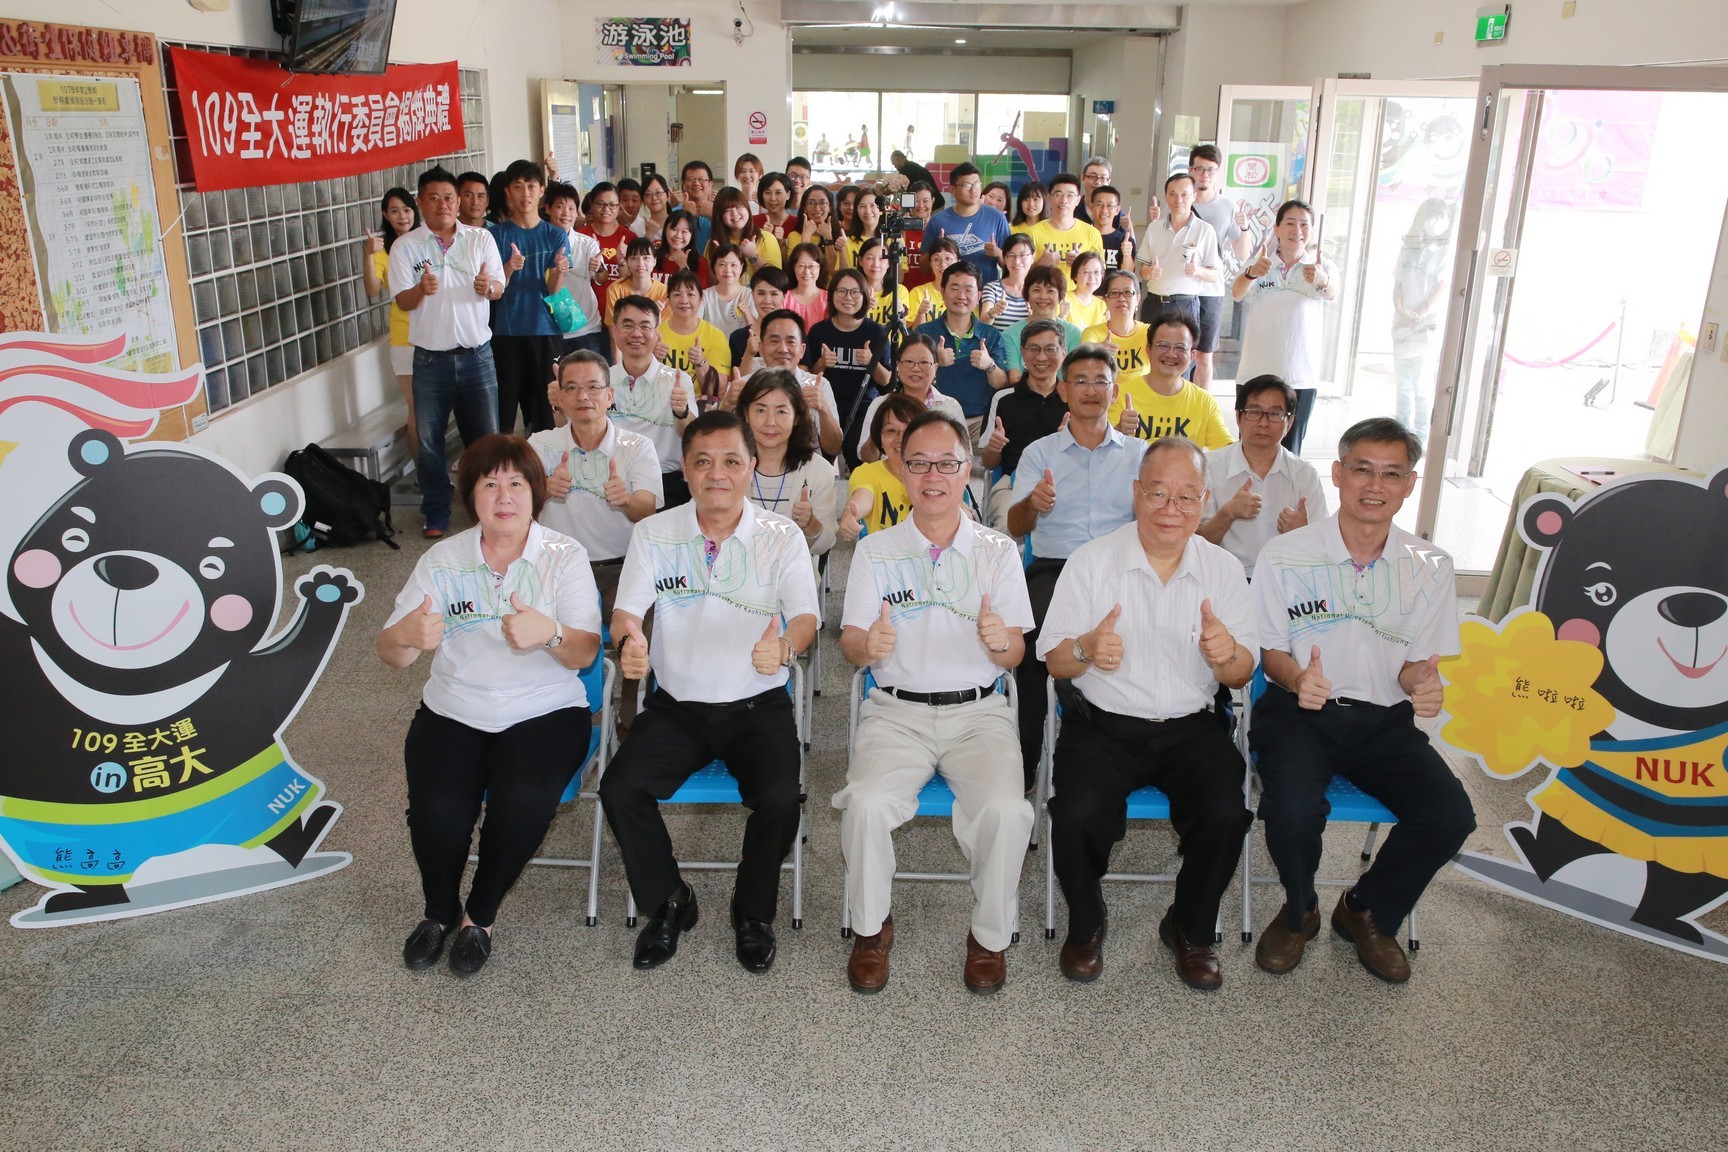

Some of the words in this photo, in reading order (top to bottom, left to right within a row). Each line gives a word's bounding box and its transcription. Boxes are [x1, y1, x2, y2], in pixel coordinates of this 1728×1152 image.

[602, 23, 687, 46] 游泳池
[624, 52, 658, 61] Swimming
[660, 52, 674, 60] Pool
[192, 82, 451, 160] 109全大運執行委員會揭牌典禮
[1260, 281, 1275, 290] NUK
[655, 576, 687, 594] NUK
[882, 589, 915, 606] NUK
[1288, 600, 1329, 620] NUK
[1512, 676, 1586, 711] 熊啦啦
[128, 745, 214, 793] 高大
[1635, 756, 1716, 788] NUK
[267, 778, 306, 815] NUK
